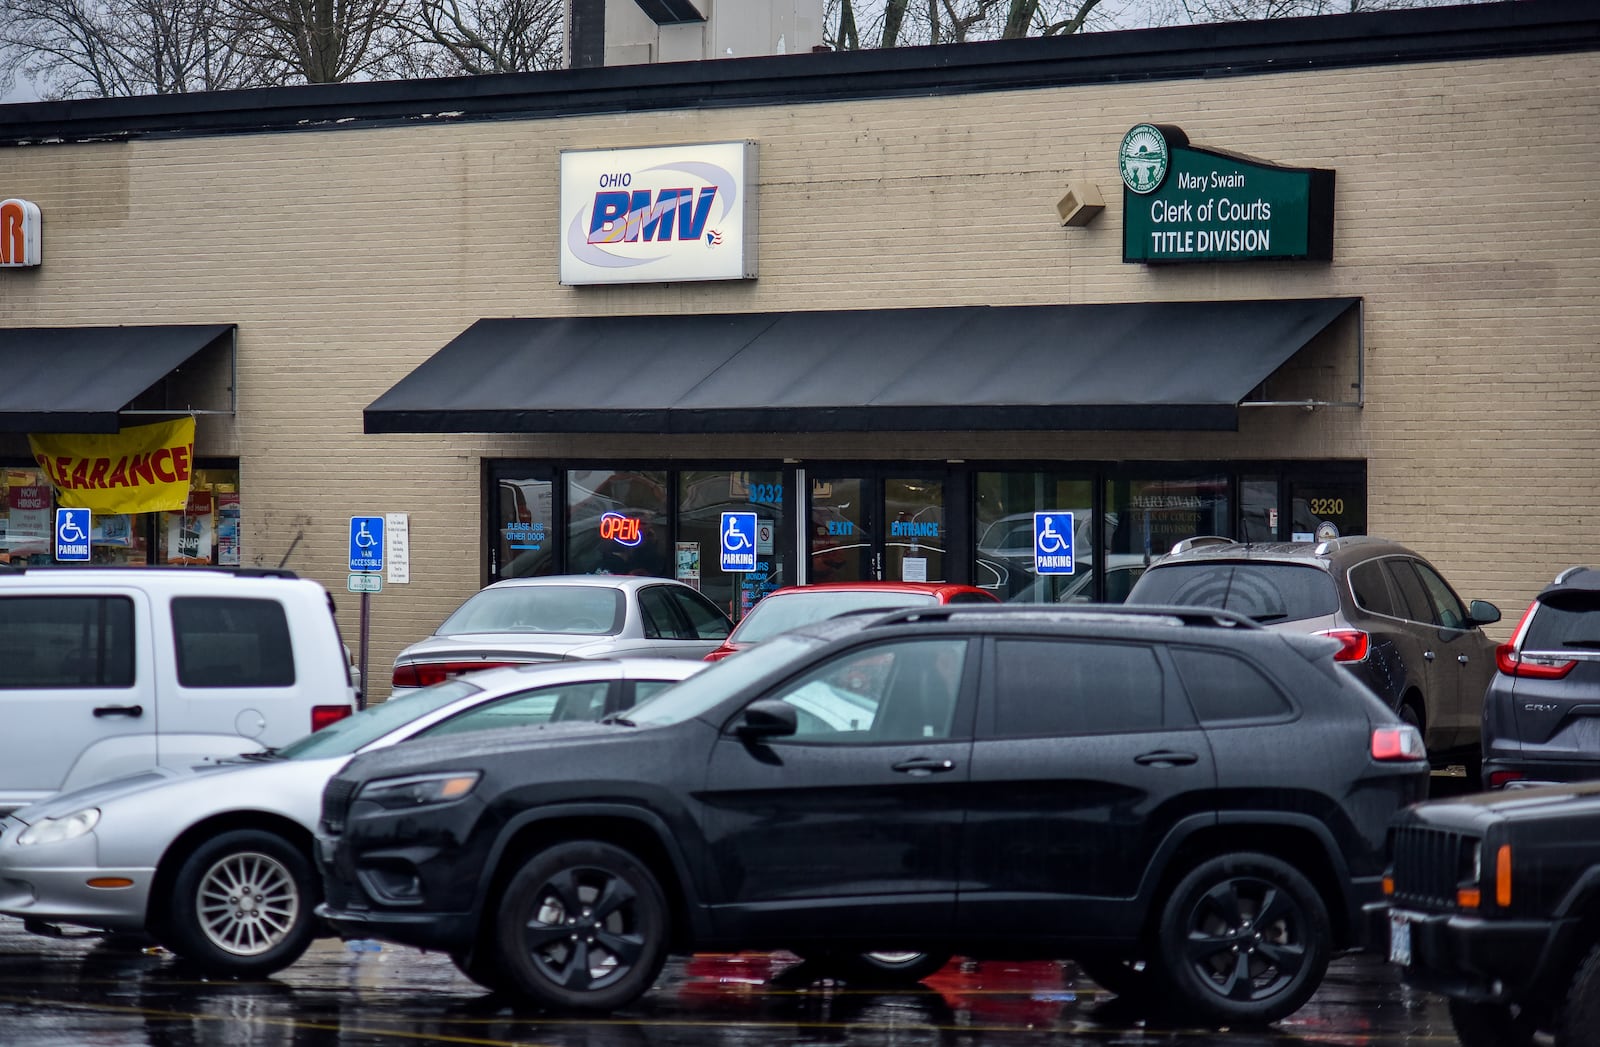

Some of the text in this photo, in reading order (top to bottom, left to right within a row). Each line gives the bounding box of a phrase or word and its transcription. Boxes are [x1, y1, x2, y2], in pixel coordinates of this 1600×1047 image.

[599, 172, 632, 188] OHIO
[1123, 169, 1137, 188] BUTLER
[1137, 181, 1156, 190] COUNTY
[1178, 171, 1245, 192] Mary Swain
[587, 186, 718, 244] BMV
[1151, 197, 1271, 223] Clerk of Courts
[1151, 229, 1270, 253] TITLE DIVISION
[20, 488, 38, 496] NOW
[749, 484, 783, 503] 3232
[1133, 496, 1202, 508] MARY SWAIN
[1310, 498, 1344, 514] 3230
[507, 523, 544, 531] PLEASE USE
[600, 517, 641, 541] OPEN
[829, 521, 854, 535] EXIT
[891, 522, 939, 537] ENTRANCE
[506, 532, 545, 541] OTHER DOOR
[59, 545, 88, 555] PARKING
[351, 559, 382, 567] ACCESSIBLE
[723, 554, 753, 565] PARKING
[1037, 556, 1072, 568] PARKING
[1524, 704, 1558, 712] CR-V
